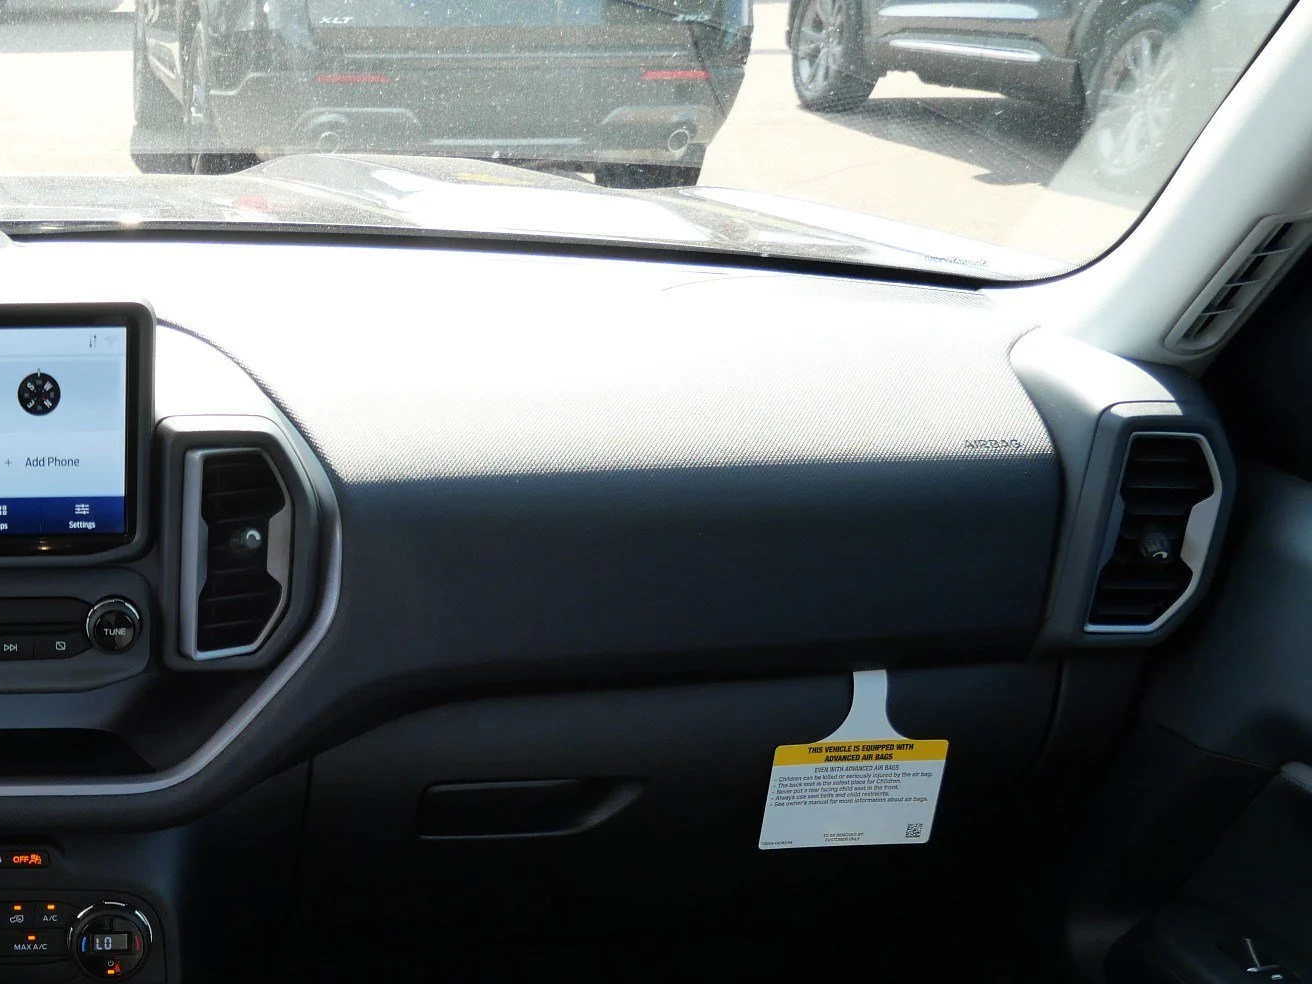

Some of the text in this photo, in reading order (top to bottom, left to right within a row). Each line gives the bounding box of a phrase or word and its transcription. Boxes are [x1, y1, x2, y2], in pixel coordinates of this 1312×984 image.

[319, 16, 355, 24] XLT
[25, 456, 80, 467] Add Phone
[69, 521, 96, 529] Settings
[103, 628, 126, 636] TUNE
[862, 744, 894, 752] EQUIPPED
[824, 754, 860, 762] ADVANCED
[12, 856, 30, 864] OFF
